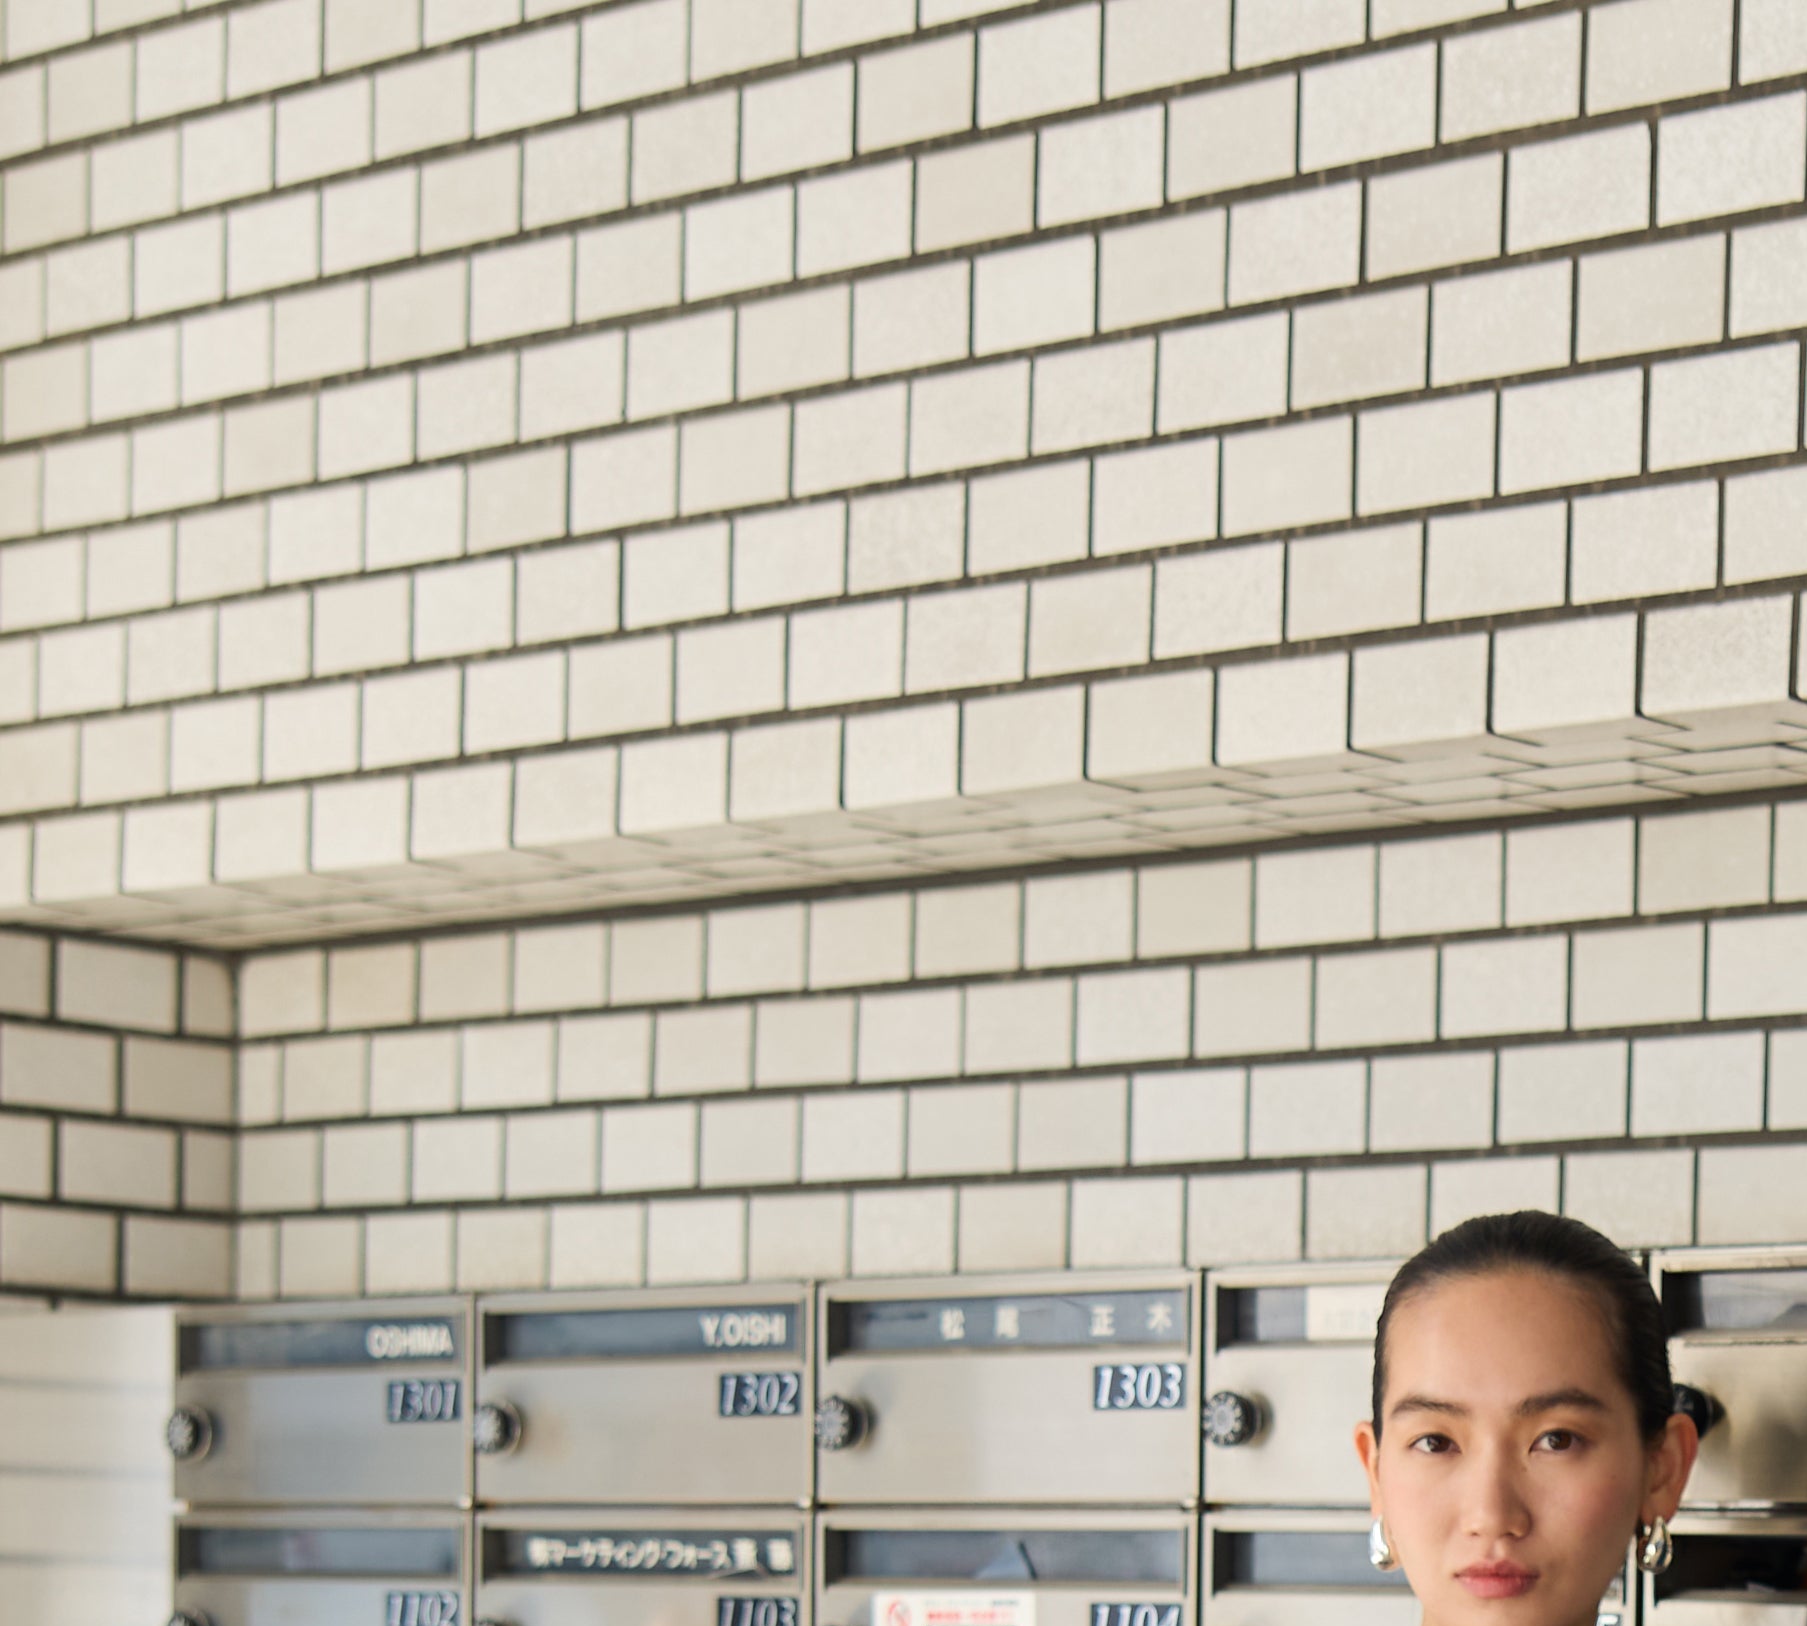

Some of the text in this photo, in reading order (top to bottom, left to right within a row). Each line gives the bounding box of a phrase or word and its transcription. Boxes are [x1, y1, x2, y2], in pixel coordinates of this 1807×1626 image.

[389, 1381, 457, 1422] 1301
[721, 1373, 799, 1415] 1302
[1097, 1365, 1183, 1409] 1303
[528, 1536, 730, 1570] マーケティング・フォース
